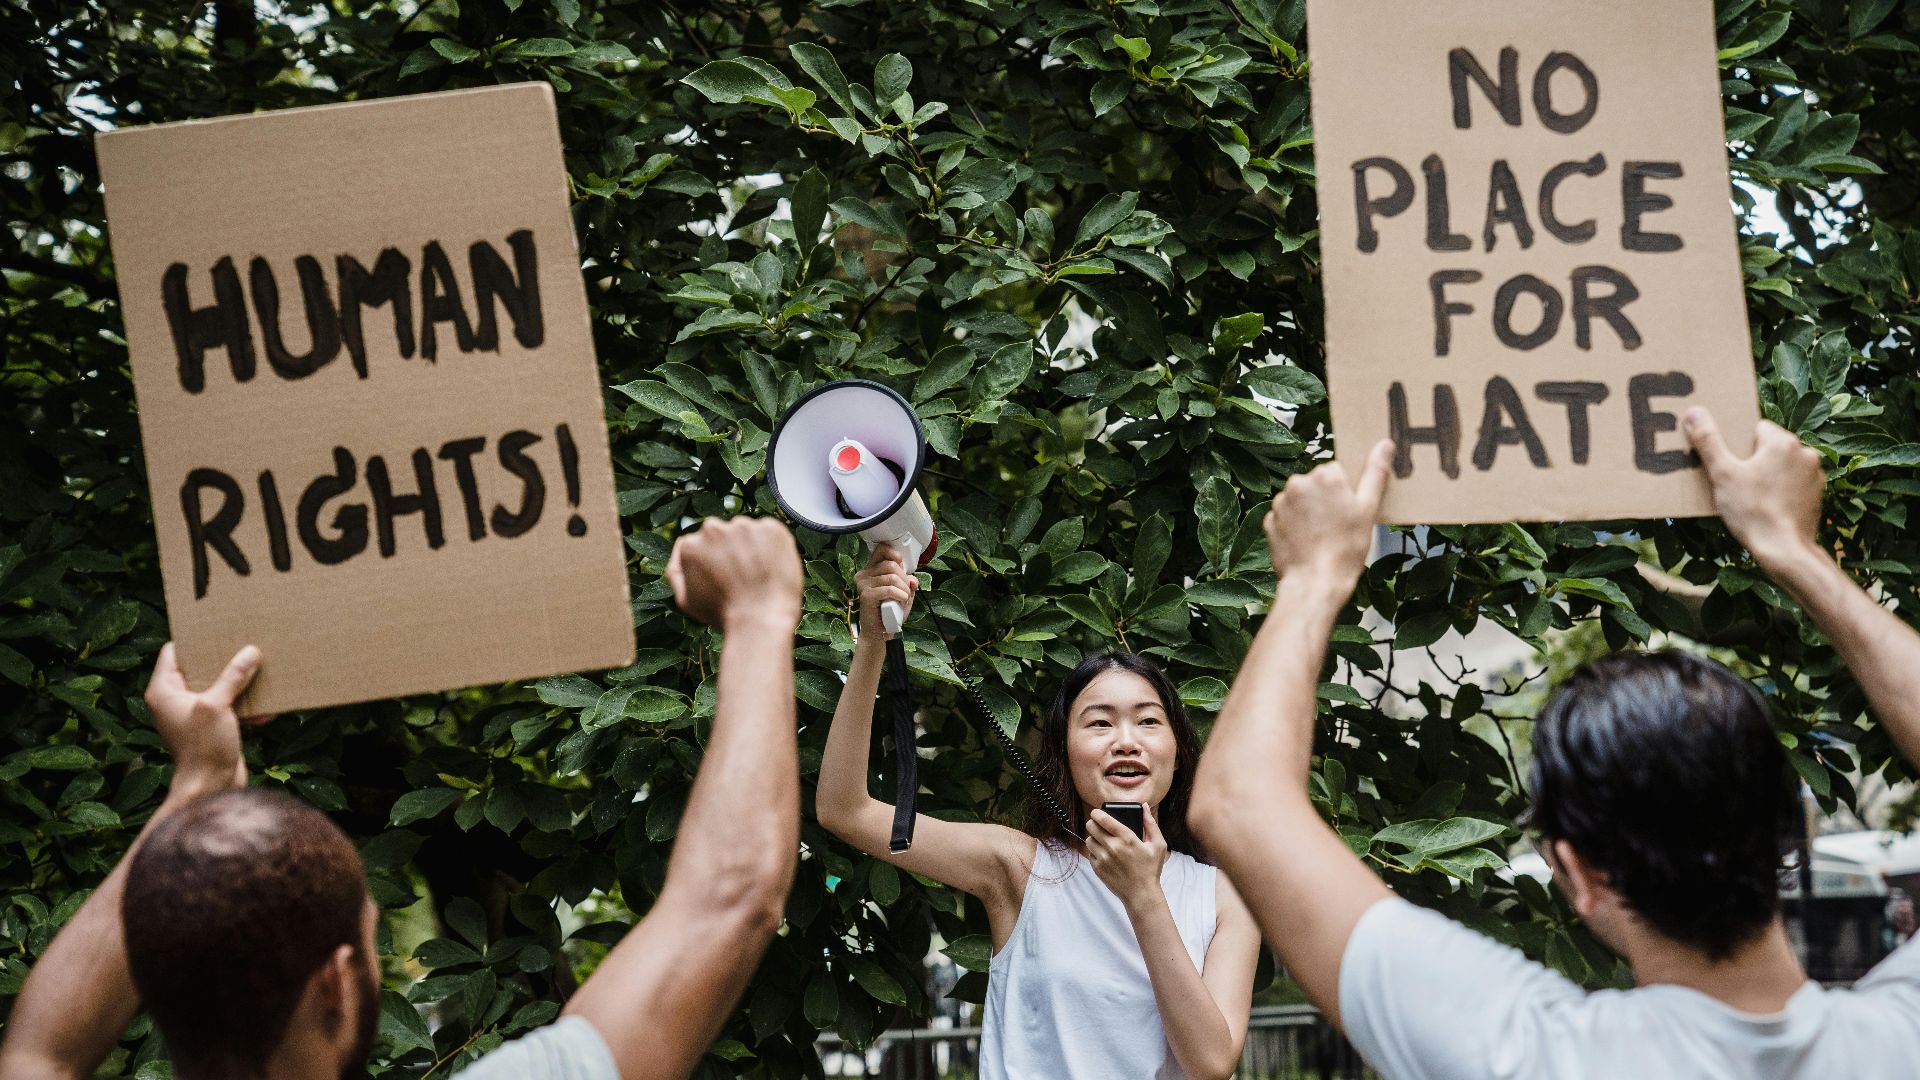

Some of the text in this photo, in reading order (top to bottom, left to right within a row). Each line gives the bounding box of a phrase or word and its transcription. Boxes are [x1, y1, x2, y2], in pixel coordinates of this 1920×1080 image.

[1448, 44, 1599, 135] NO
[1351, 152, 1684, 254] PLACE
[161, 229, 544, 394] HUMAN
[1429, 264, 1643, 357] FOR
[1387, 371, 1702, 479] HATE
[180, 423, 587, 600] RIGHTS!
